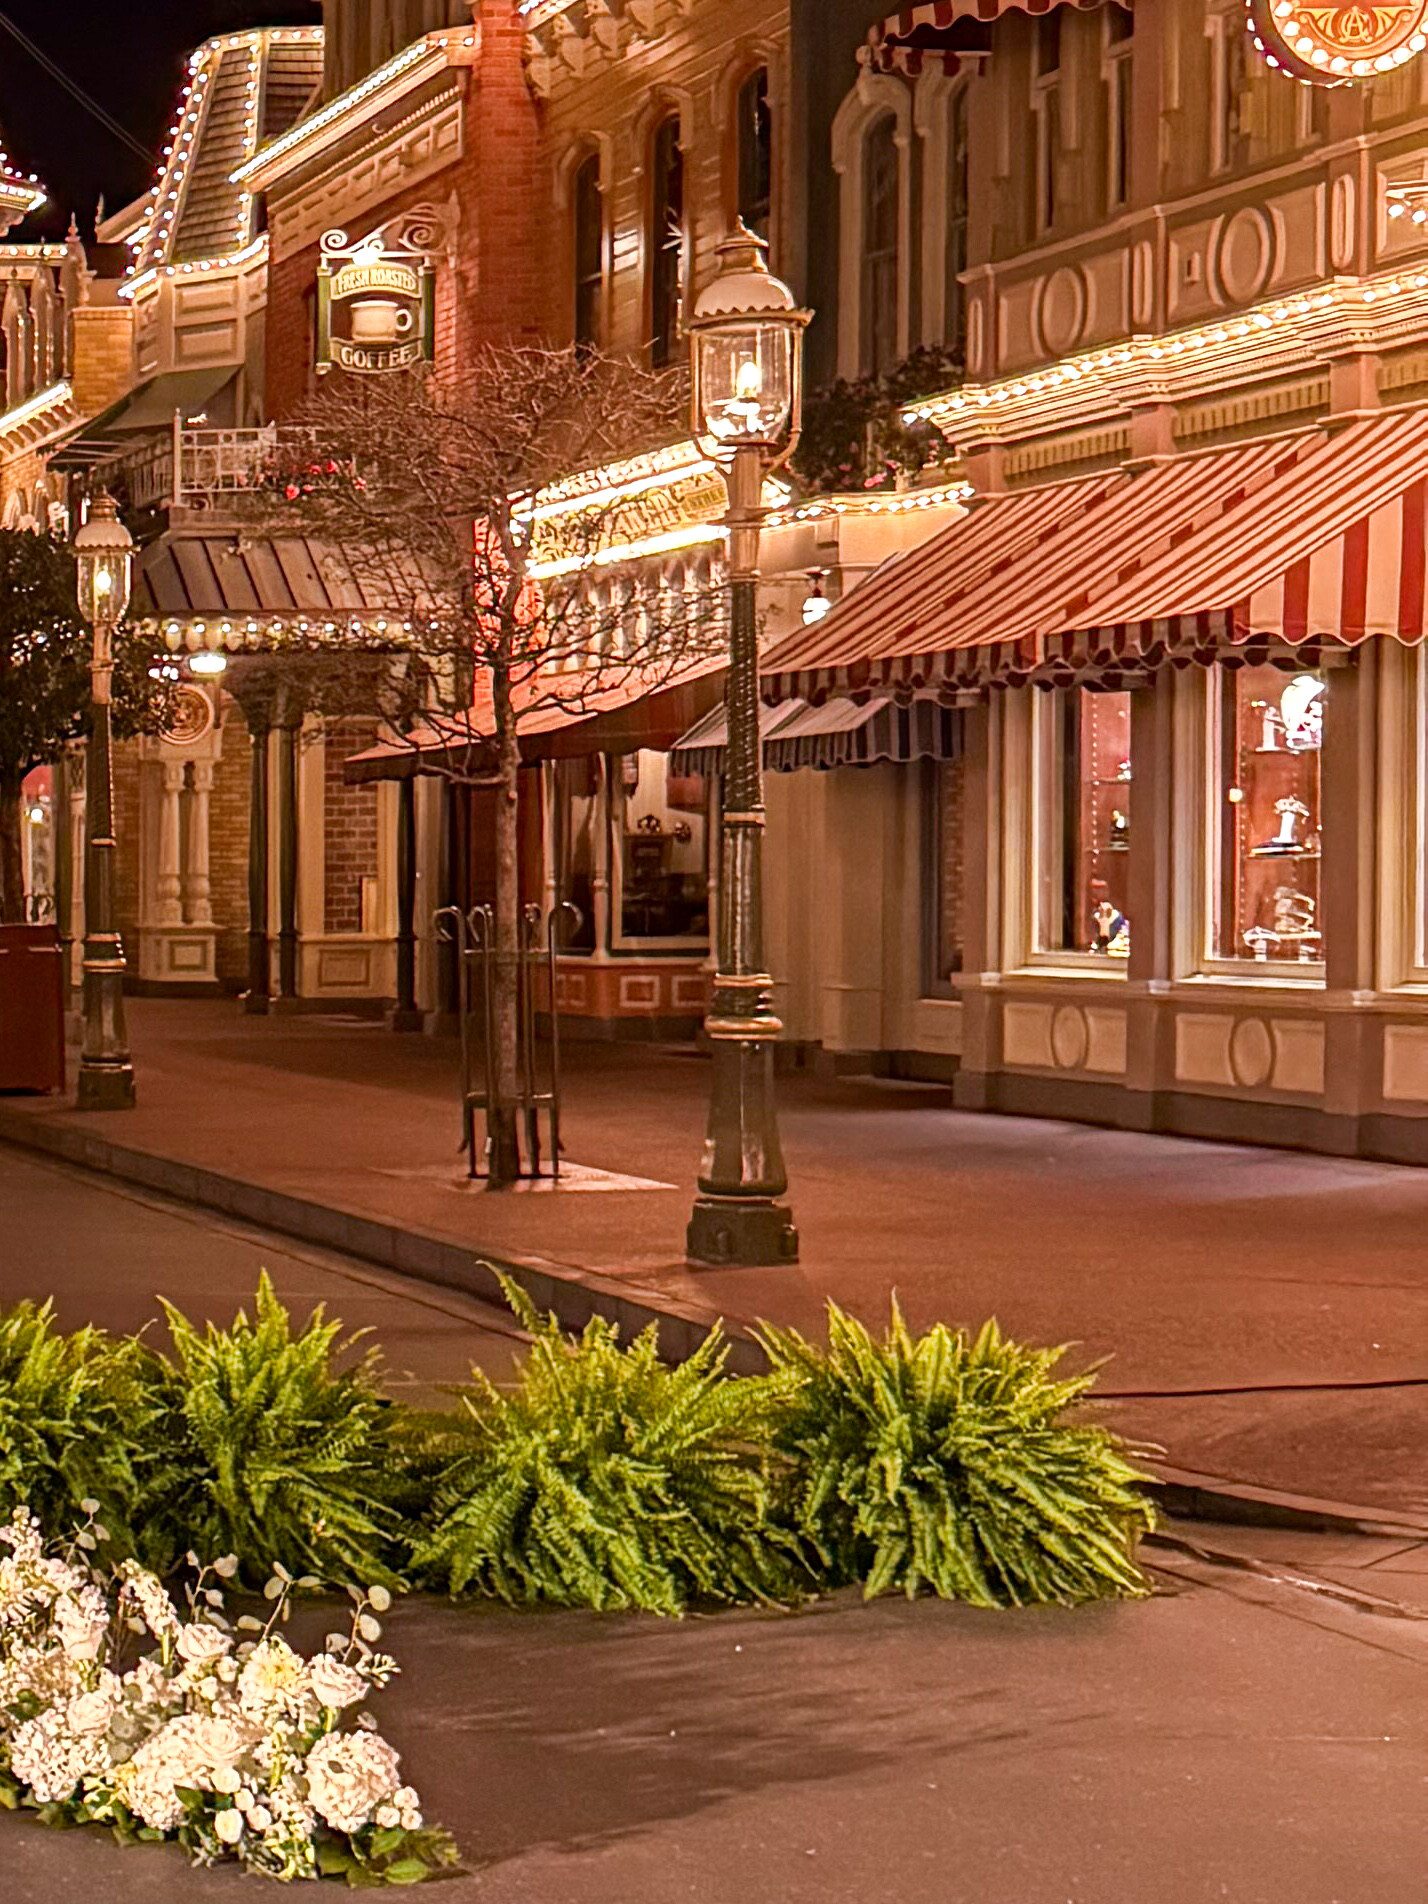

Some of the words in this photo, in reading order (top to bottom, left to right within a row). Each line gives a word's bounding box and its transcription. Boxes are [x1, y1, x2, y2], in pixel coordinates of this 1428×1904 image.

[337, 269, 370, 294] FRESH
[370, 268, 416, 291] ROASTED
[341, 346, 412, 369] COFFEE
